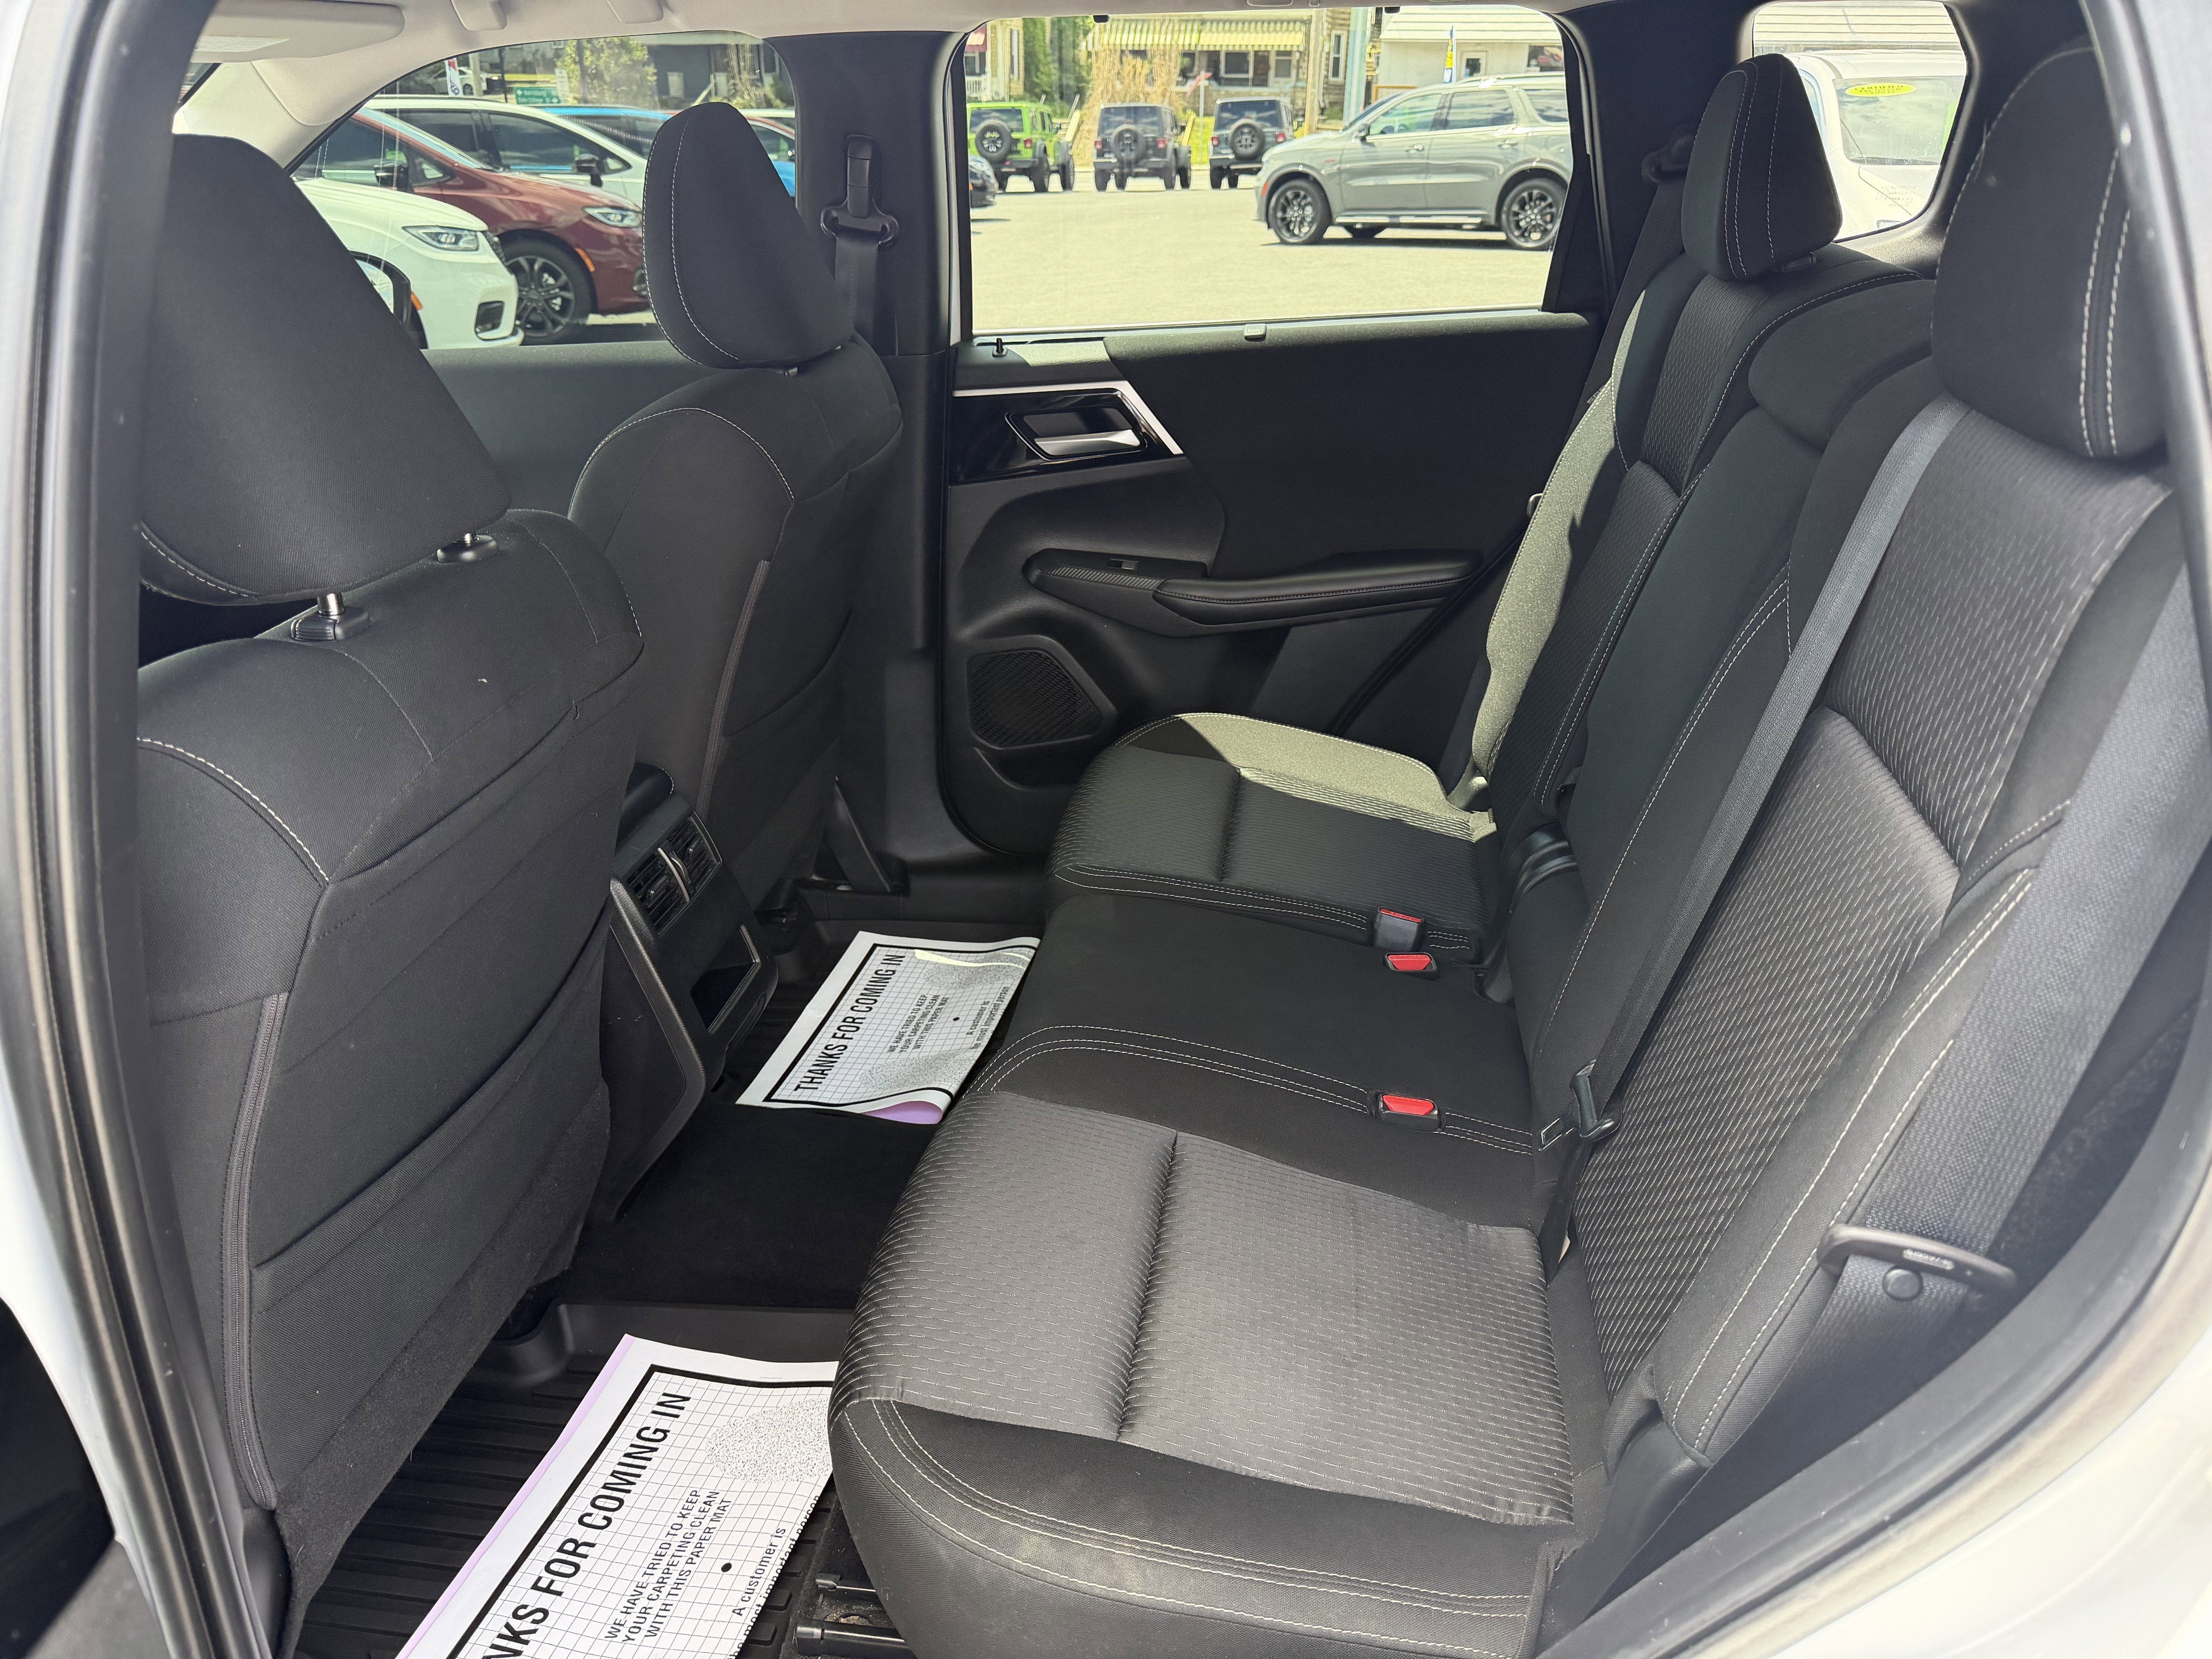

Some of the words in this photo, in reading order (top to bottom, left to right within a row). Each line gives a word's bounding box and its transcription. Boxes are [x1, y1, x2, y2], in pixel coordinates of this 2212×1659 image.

[794, 1044, 848, 1091] THANKS
[831, 1016, 866, 1040] FOR
[850, 969, 896, 1012] COMING
[881, 955, 905, 965] IN
[893, 1031, 907, 1043] HAVE
[901, 1015, 916, 1029] TRIED
[915, 994, 927, 1006] KEEP
[912, 1036, 926, 1049] WITH
[921, 1023, 934, 1034] THIS
[928, 1007, 943, 1022] PAPER
[938, 997, 950, 1006] MAT
[970, 1006, 987, 1030] customer
[982, 1003, 1002, 1026] important
[996, 986, 1009, 1002] person
[898, 1038, 914, 1053] YOUR
[908, 1011, 930, 1037] CARPETING
[925, 995, 940, 1010] CLEAN
[977, 1028, 988, 1041] most
[531, 1538, 597, 1597] FOR
[578, 1426, 671, 1530] COMING
[651, 1393, 691, 1418] IN
[604, 1618, 627, 1638] WE
[620, 1582, 649, 1614] HAVE
[642, 1542, 672, 1578] TRIED
[665, 1523, 683, 1538] TO
[677, 1490, 700, 1518] KEEP
[622, 1606, 653, 1642] YOUR
[647, 1532, 696, 1601] CARPETING
[690, 1491, 720, 1527] CLEAN
[644, 1603, 673, 1637] WITH
[666, 1570, 691, 1598] THIS
[685, 1527, 716, 1565] PAPER
[709, 1499, 732, 1522] MAT
[732, 1607, 746, 1616] A
[741, 1542, 778, 1602] customer
[771, 1528, 786, 1538] is
